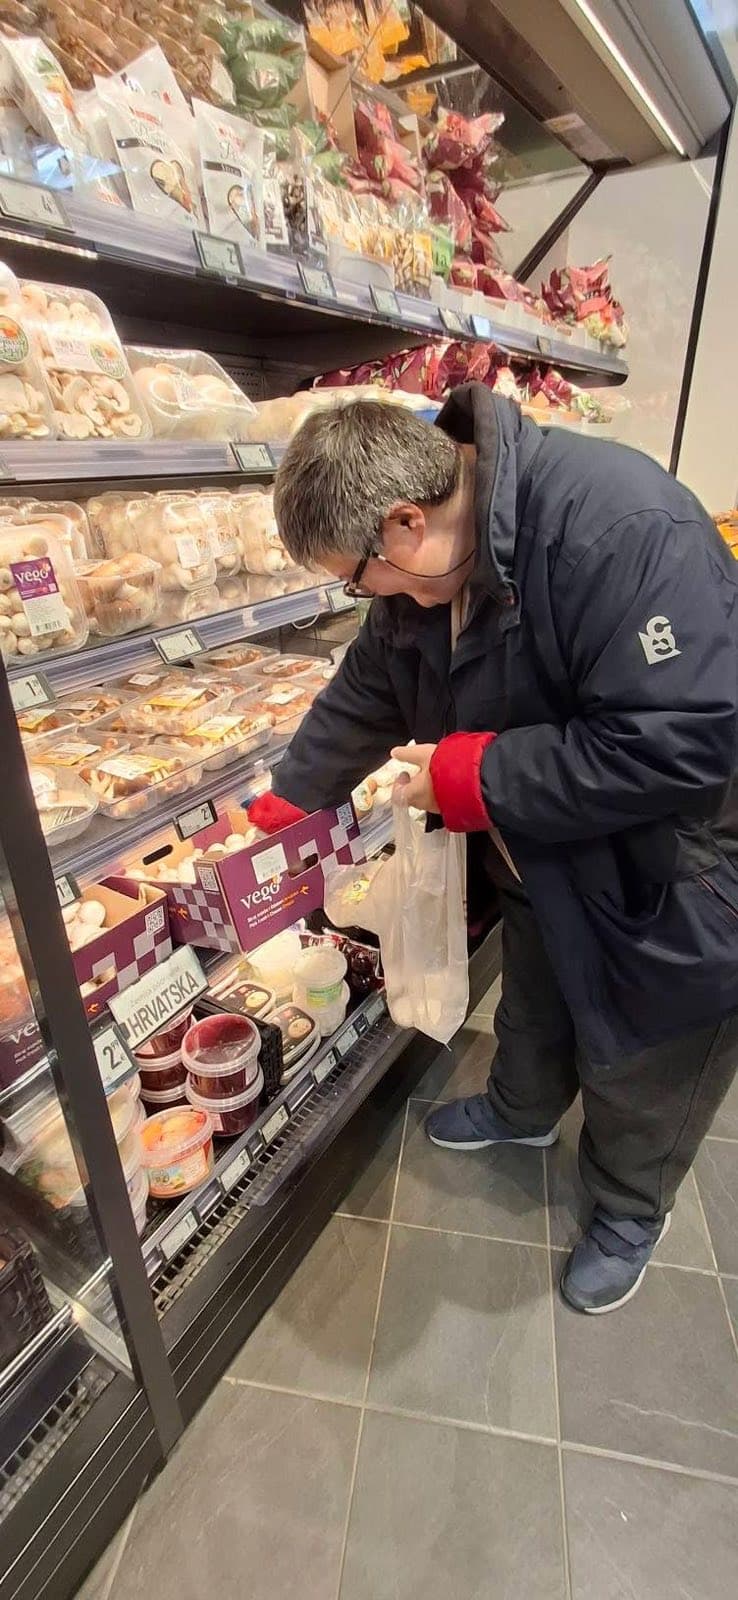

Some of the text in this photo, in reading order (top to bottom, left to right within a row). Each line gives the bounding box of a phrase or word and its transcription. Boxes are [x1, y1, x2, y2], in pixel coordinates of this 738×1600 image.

[15, 568, 50, 584] vego
[240, 879, 282, 910] vego
[126, 970, 200, 1039] HRVATSKA
[9, 1021, 40, 1044] ve
